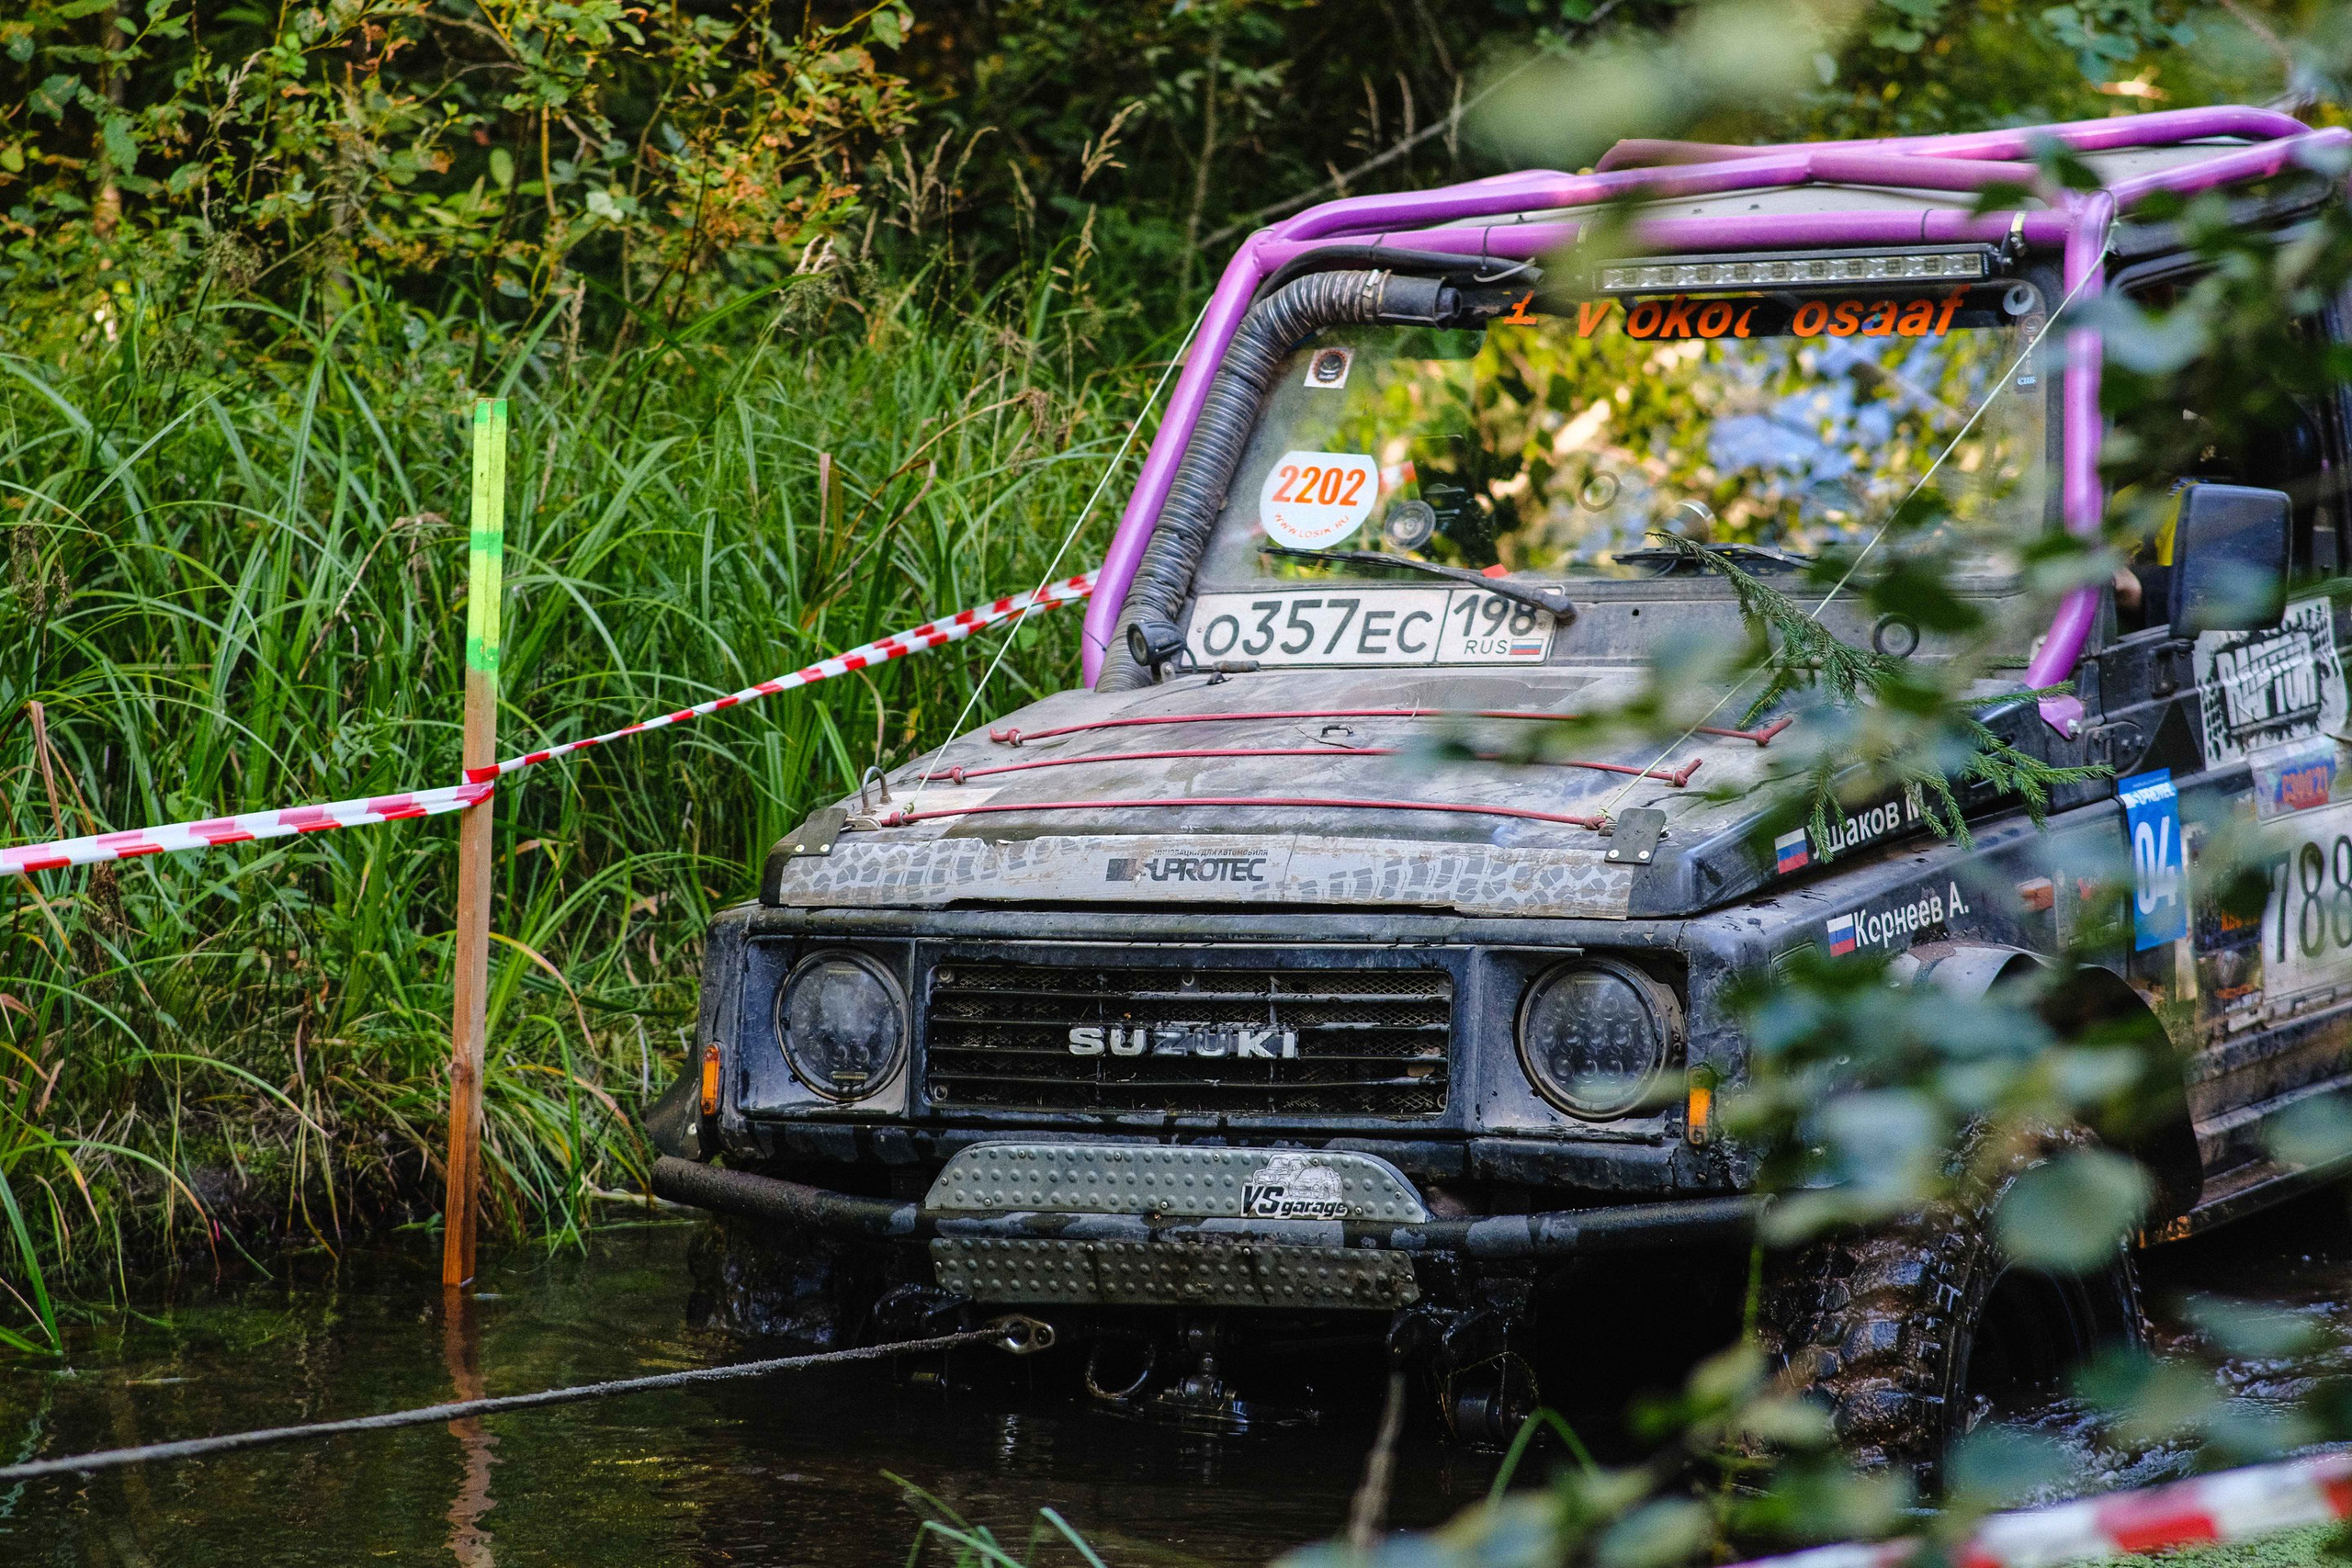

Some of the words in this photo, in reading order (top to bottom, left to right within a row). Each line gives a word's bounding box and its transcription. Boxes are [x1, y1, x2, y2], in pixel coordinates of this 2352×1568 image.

[1272, 465, 1366, 506] 2202
[1453, 594, 1537, 637] 198
[1464, 639, 1508, 655] RUS
[2132, 816, 2177, 916] 04
[1854, 895, 1944, 948] Корнеев
[1949, 881, 1970, 918] А.
[1069, 1027, 1298, 1058] SUZUKI
[1242, 1186, 1284, 1214] VS
[1282, 1201, 1348, 1217] garage
